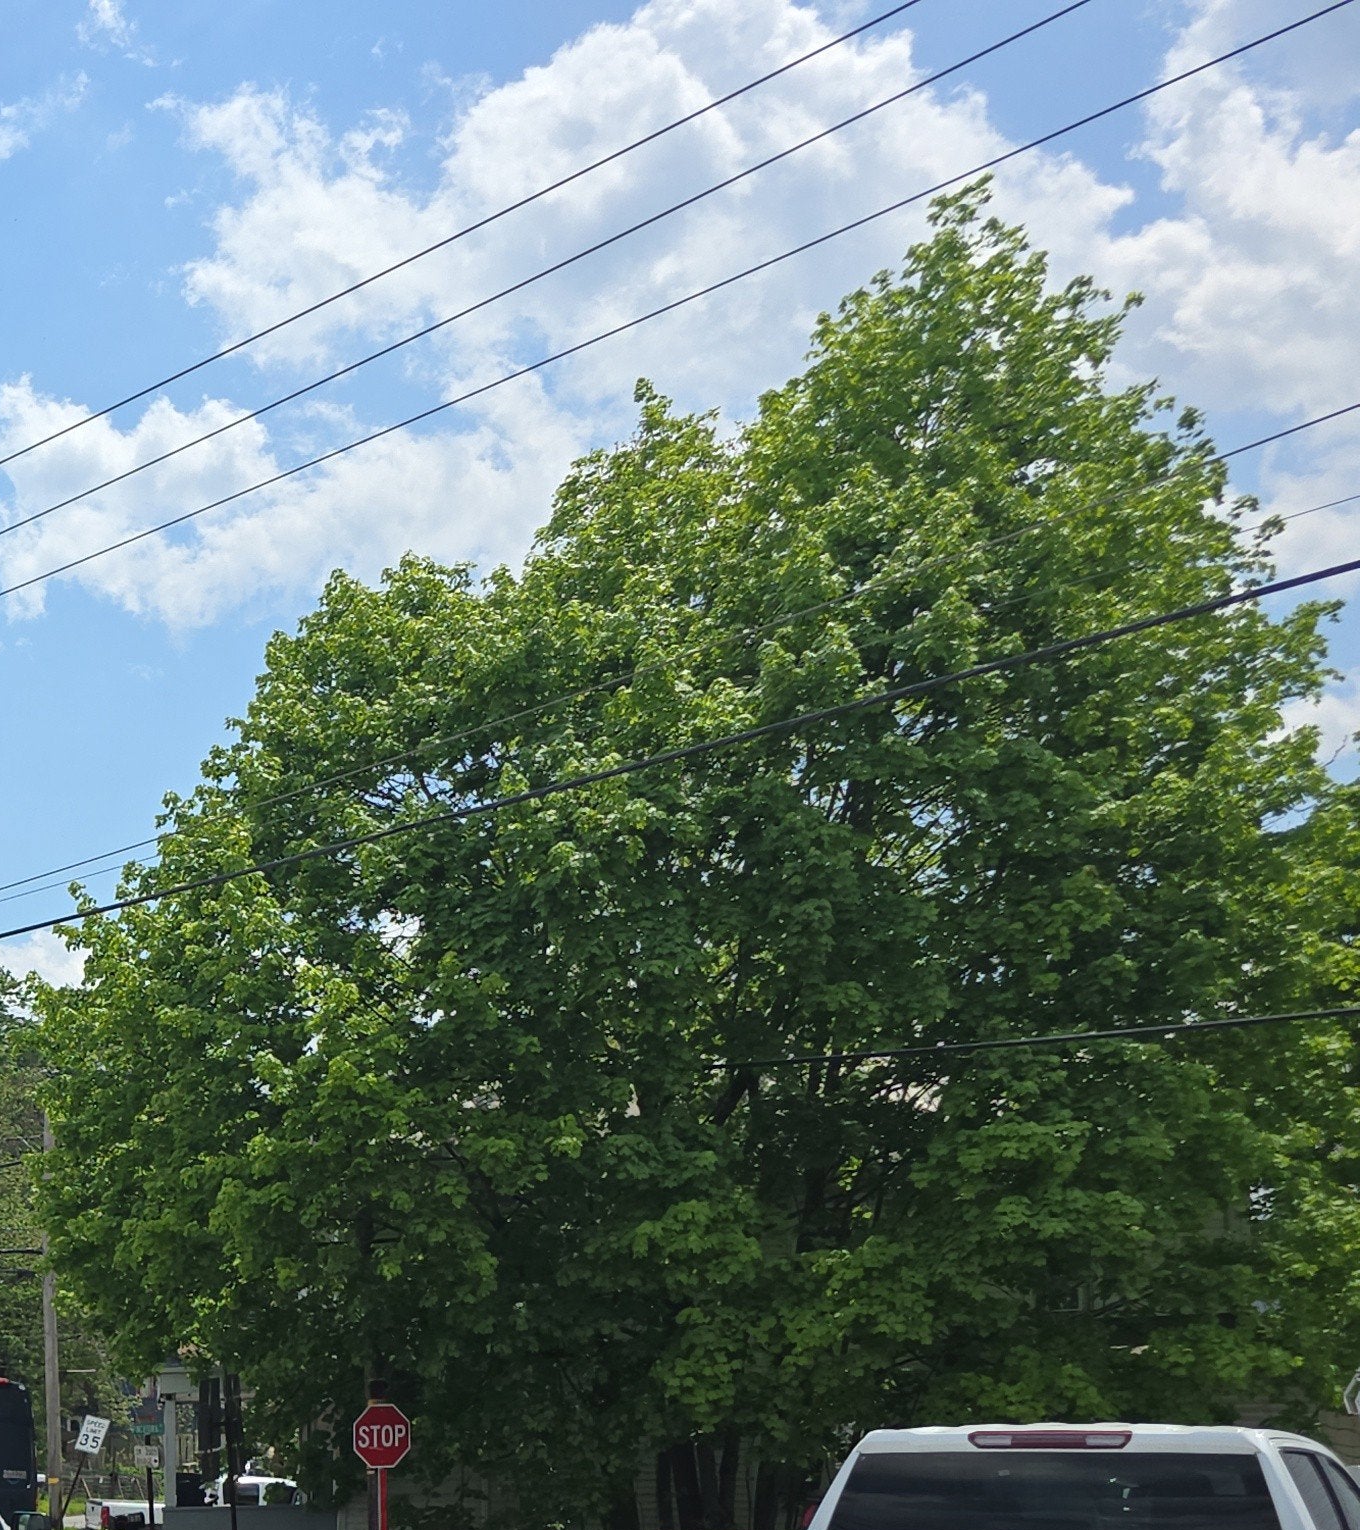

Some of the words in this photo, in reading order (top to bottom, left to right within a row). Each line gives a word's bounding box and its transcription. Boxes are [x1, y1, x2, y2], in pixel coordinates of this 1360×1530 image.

[86, 1426, 102, 1434] LIMIT
[87, 1420, 106, 1429] SPEED
[79, 1433, 101, 1449] 35
[358, 1424, 406, 1448] STOP
